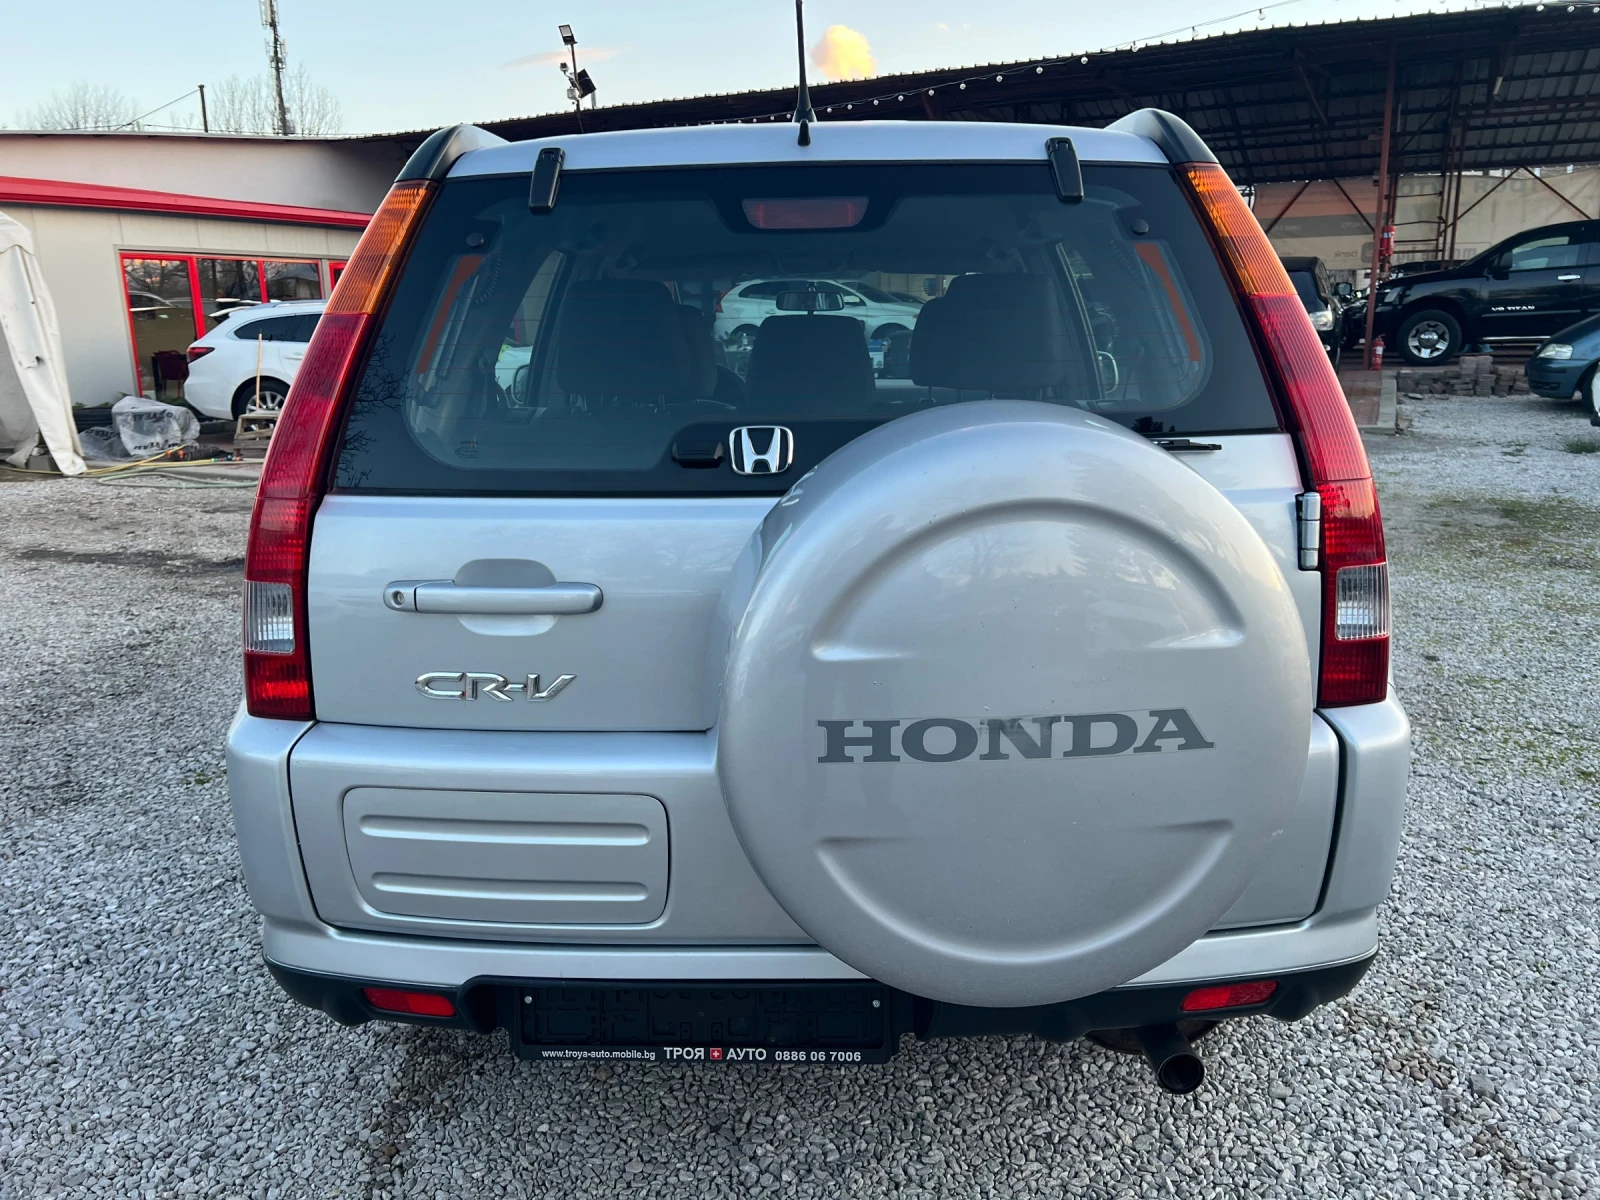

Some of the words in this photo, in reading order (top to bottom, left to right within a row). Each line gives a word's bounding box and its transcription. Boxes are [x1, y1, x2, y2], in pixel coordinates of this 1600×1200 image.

[414, 671, 577, 702] CR-V
[817, 708, 1216, 763] HONDA
[541, 1049, 656, 1061] www.troya-auto.mobile.bg
[664, 1047, 705, 1060] ТРОЯ
[726, 1048, 767, 1061] АУТО
[775, 1050, 806, 1062] 0886
[810, 1050, 826, 1062] 06
[829, 1050, 862, 1062] 7006
